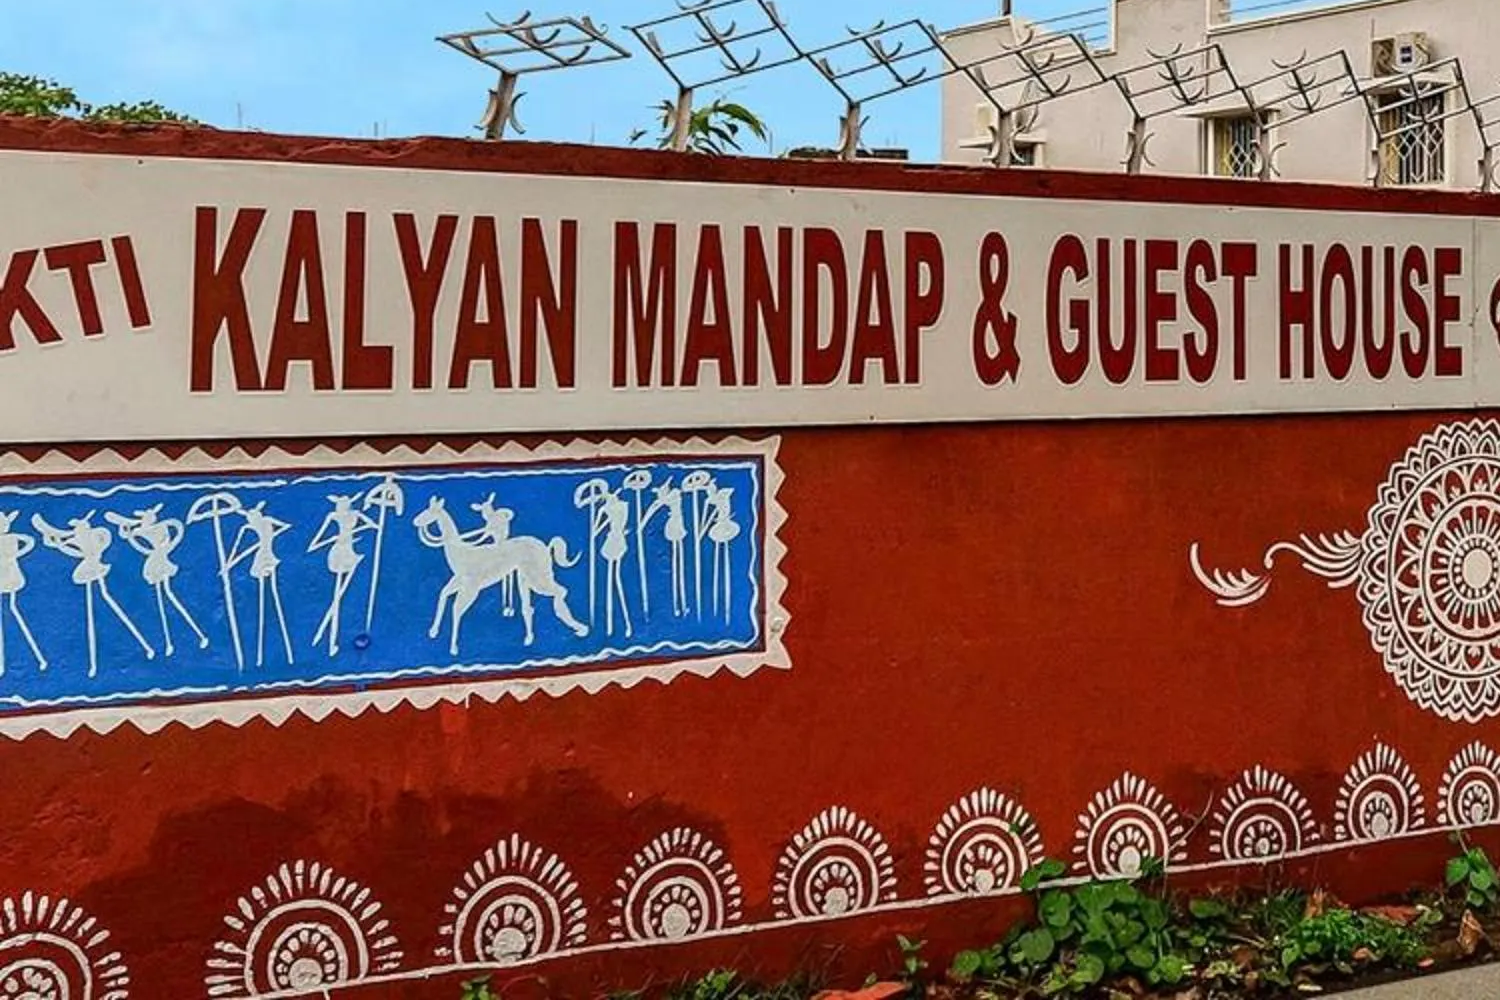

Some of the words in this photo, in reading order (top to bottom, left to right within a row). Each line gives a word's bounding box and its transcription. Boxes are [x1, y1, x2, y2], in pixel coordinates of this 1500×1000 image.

[190, 206, 577, 392] KALYAN
[612, 221, 944, 387] MANDAP
[973, 231, 1020, 385] &
[1046, 234, 1256, 384] GUEST
[1279, 242, 1462, 379] HOUSE
